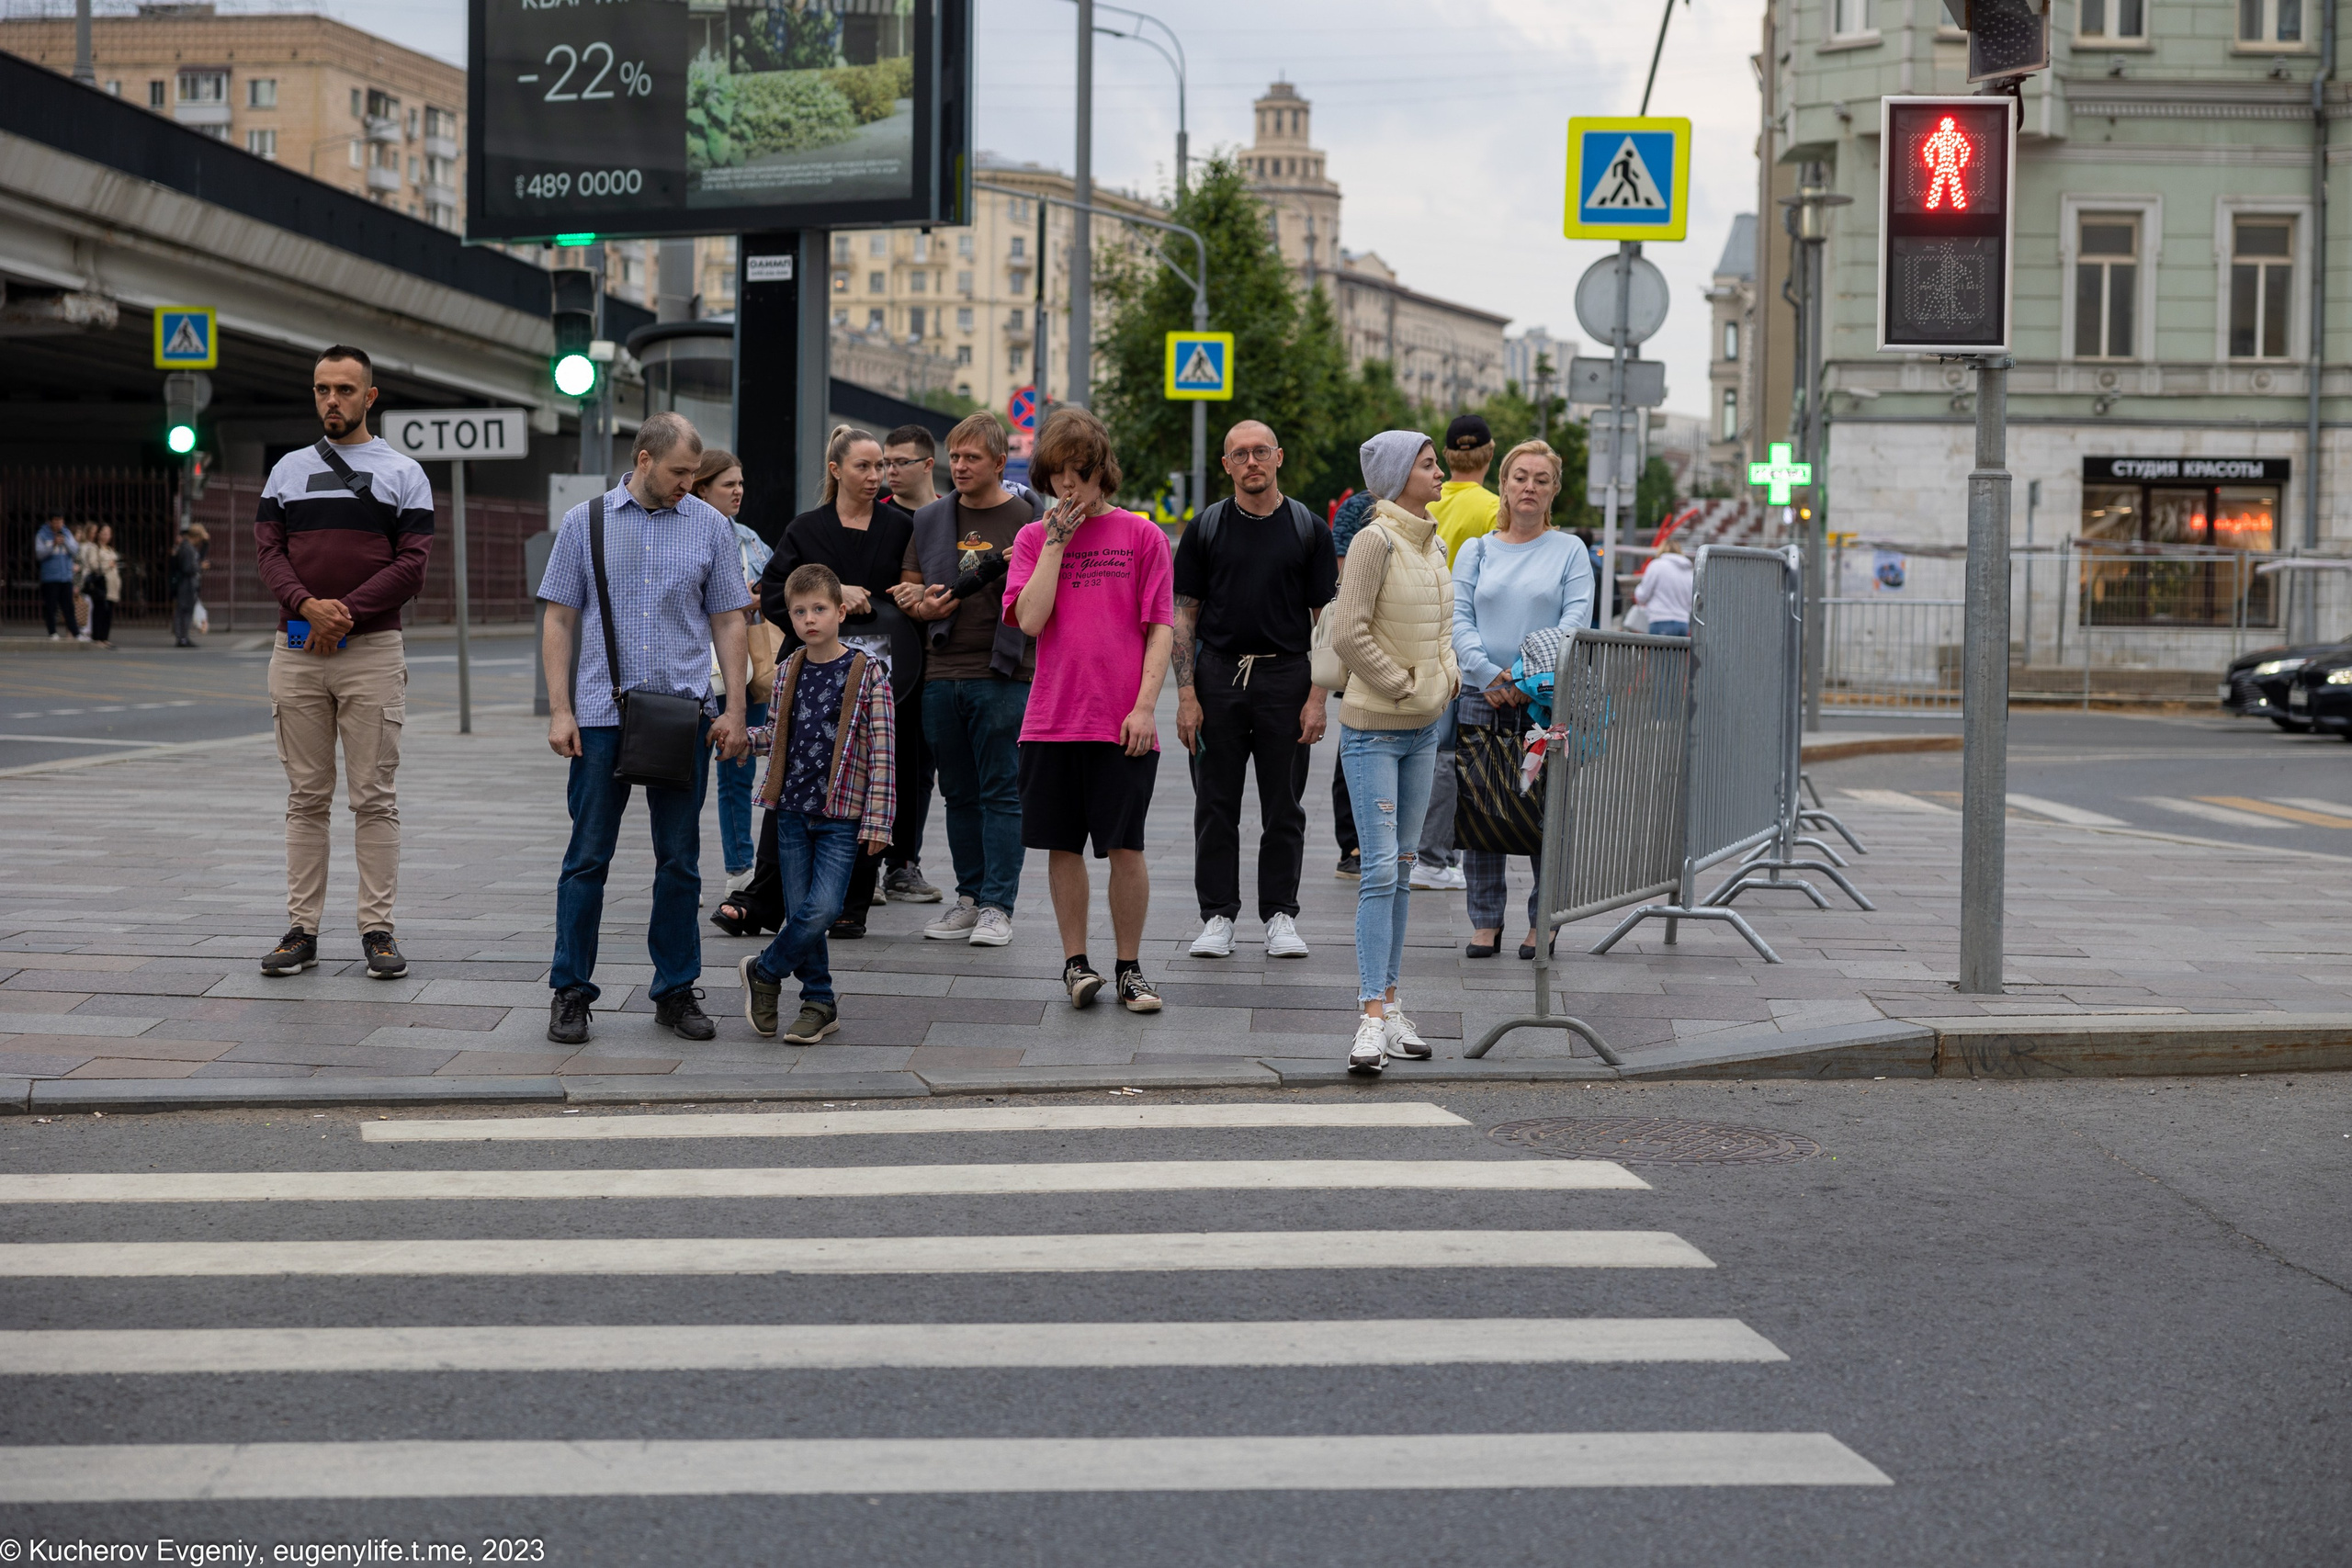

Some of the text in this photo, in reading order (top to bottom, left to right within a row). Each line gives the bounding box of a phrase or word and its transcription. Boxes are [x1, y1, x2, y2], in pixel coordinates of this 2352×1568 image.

[517, 41, 652, 102] -22%
[526, 172, 571, 198] 489
[577, 169, 642, 197] 0000
[402, 418, 504, 450] СТОП
[2111, 460, 2264, 479] СТУДИЯ КРАСОТЫ
[1062, 551, 1099, 559] siggas
[1075, 570, 1131, 580] Neudietendorf
